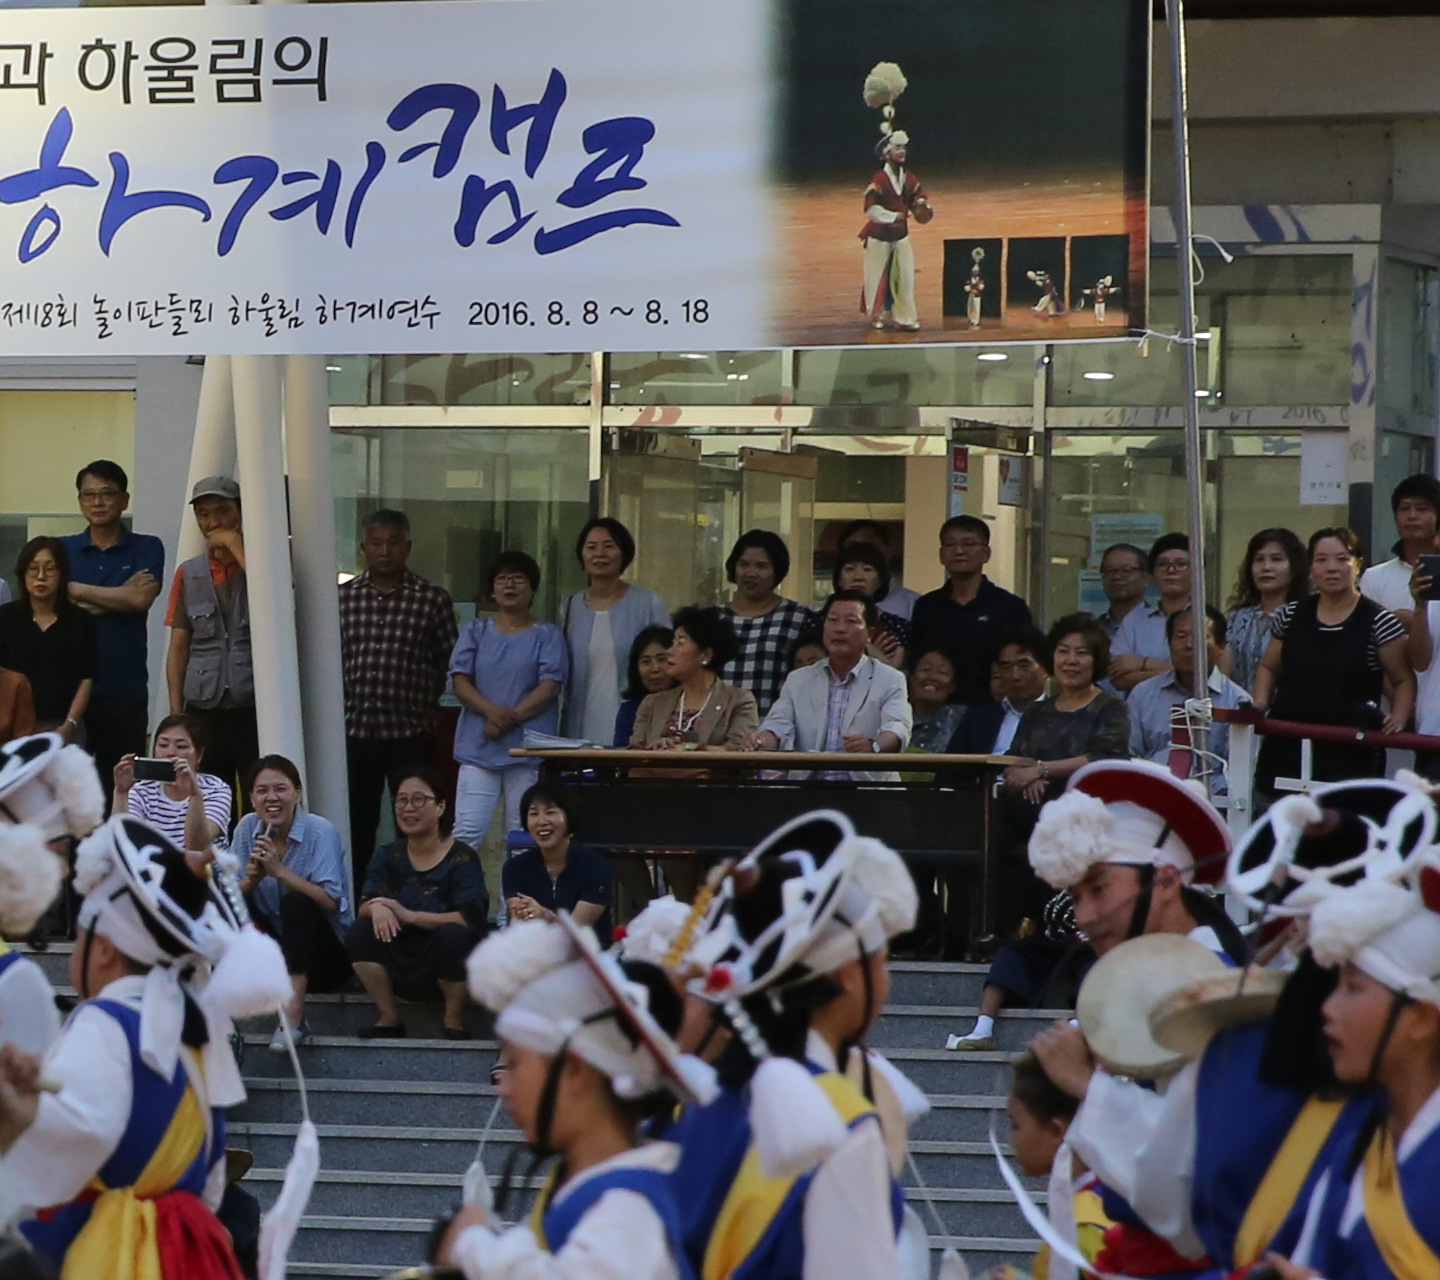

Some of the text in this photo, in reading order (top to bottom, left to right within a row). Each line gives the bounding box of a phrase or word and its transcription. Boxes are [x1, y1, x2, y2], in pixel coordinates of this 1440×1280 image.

[77, 35, 329, 104] 하울림의
[1, 293, 77, 328] 제18회
[228, 292, 305, 338] 하울림
[315, 293, 441, 330] 하계연수
[468, 301, 535, 327] 2016.
[681, 298, 709, 324] 18
